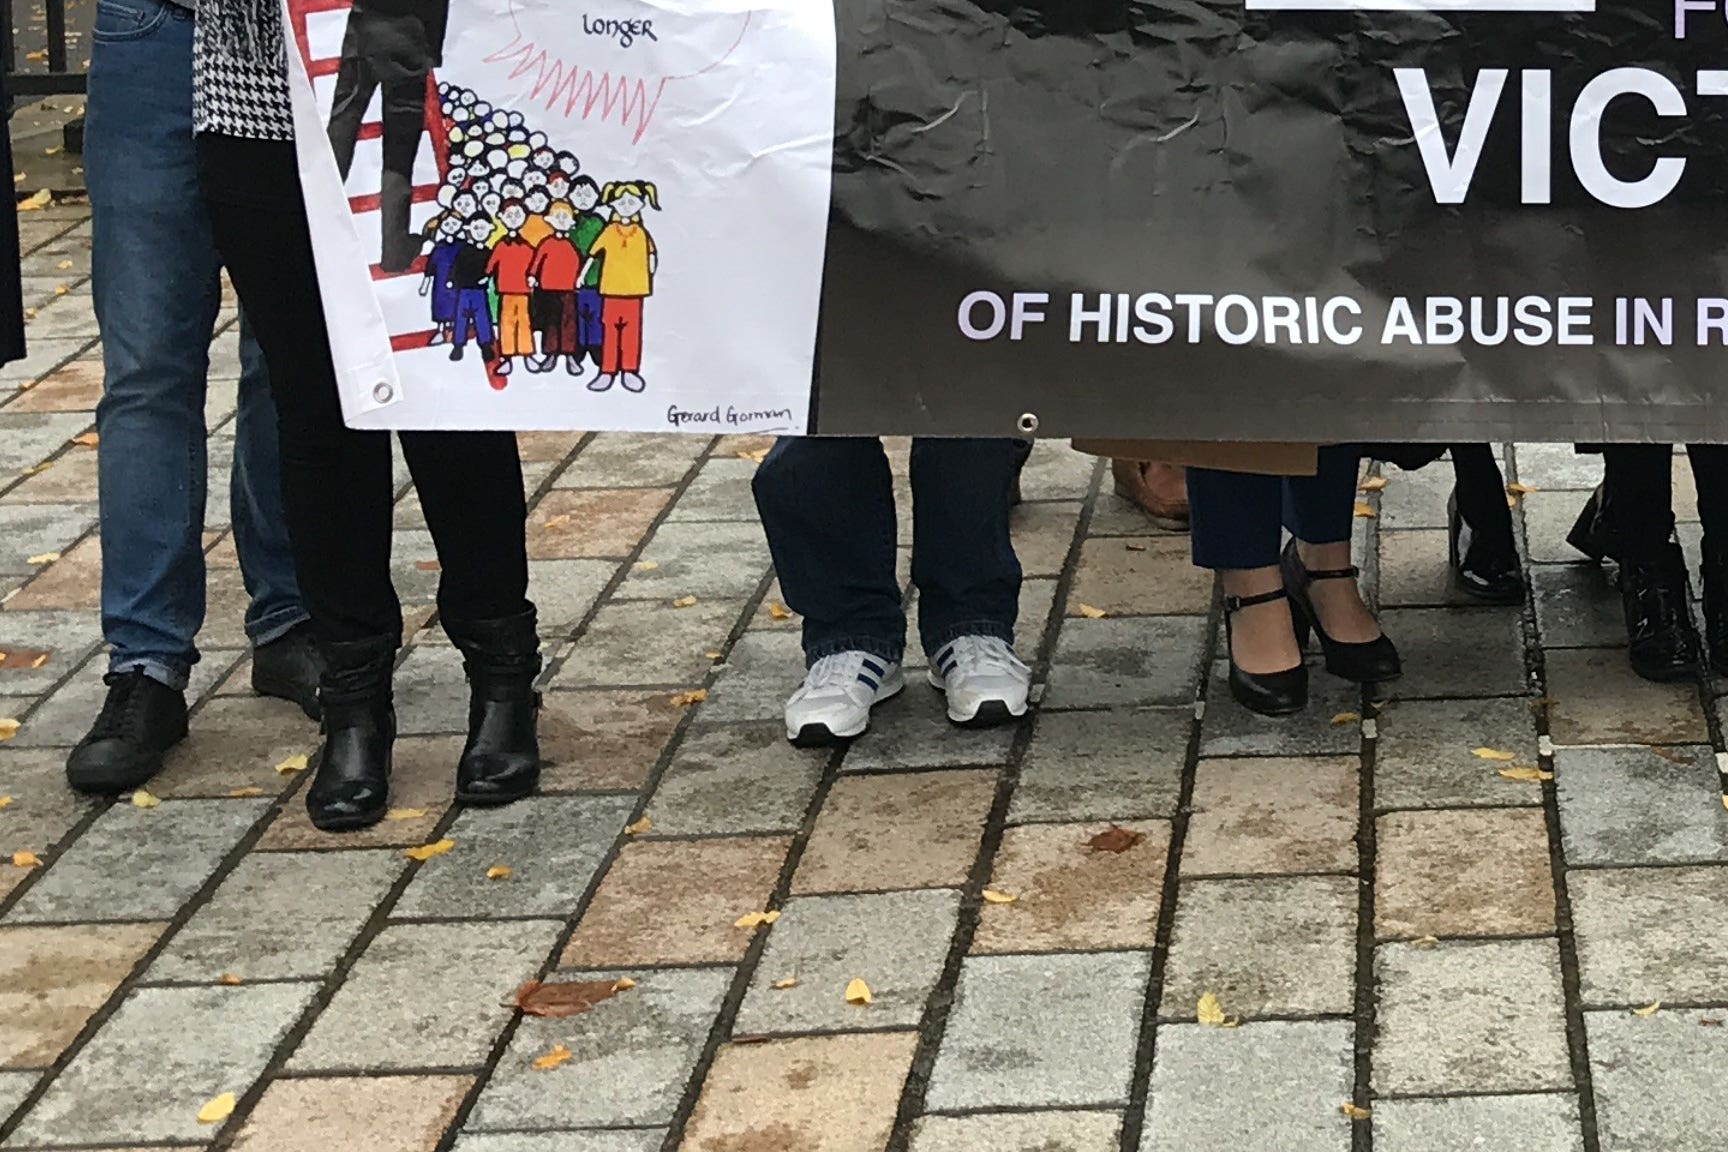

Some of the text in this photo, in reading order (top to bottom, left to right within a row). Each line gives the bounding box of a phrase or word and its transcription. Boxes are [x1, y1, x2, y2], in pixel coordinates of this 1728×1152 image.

[957, 290, 1050, 341] OF
[1068, 292, 1364, 346] HISTORIC
[1379, 294, 1595, 346] ABUSE
[1614, 296, 1674, 346] IN
